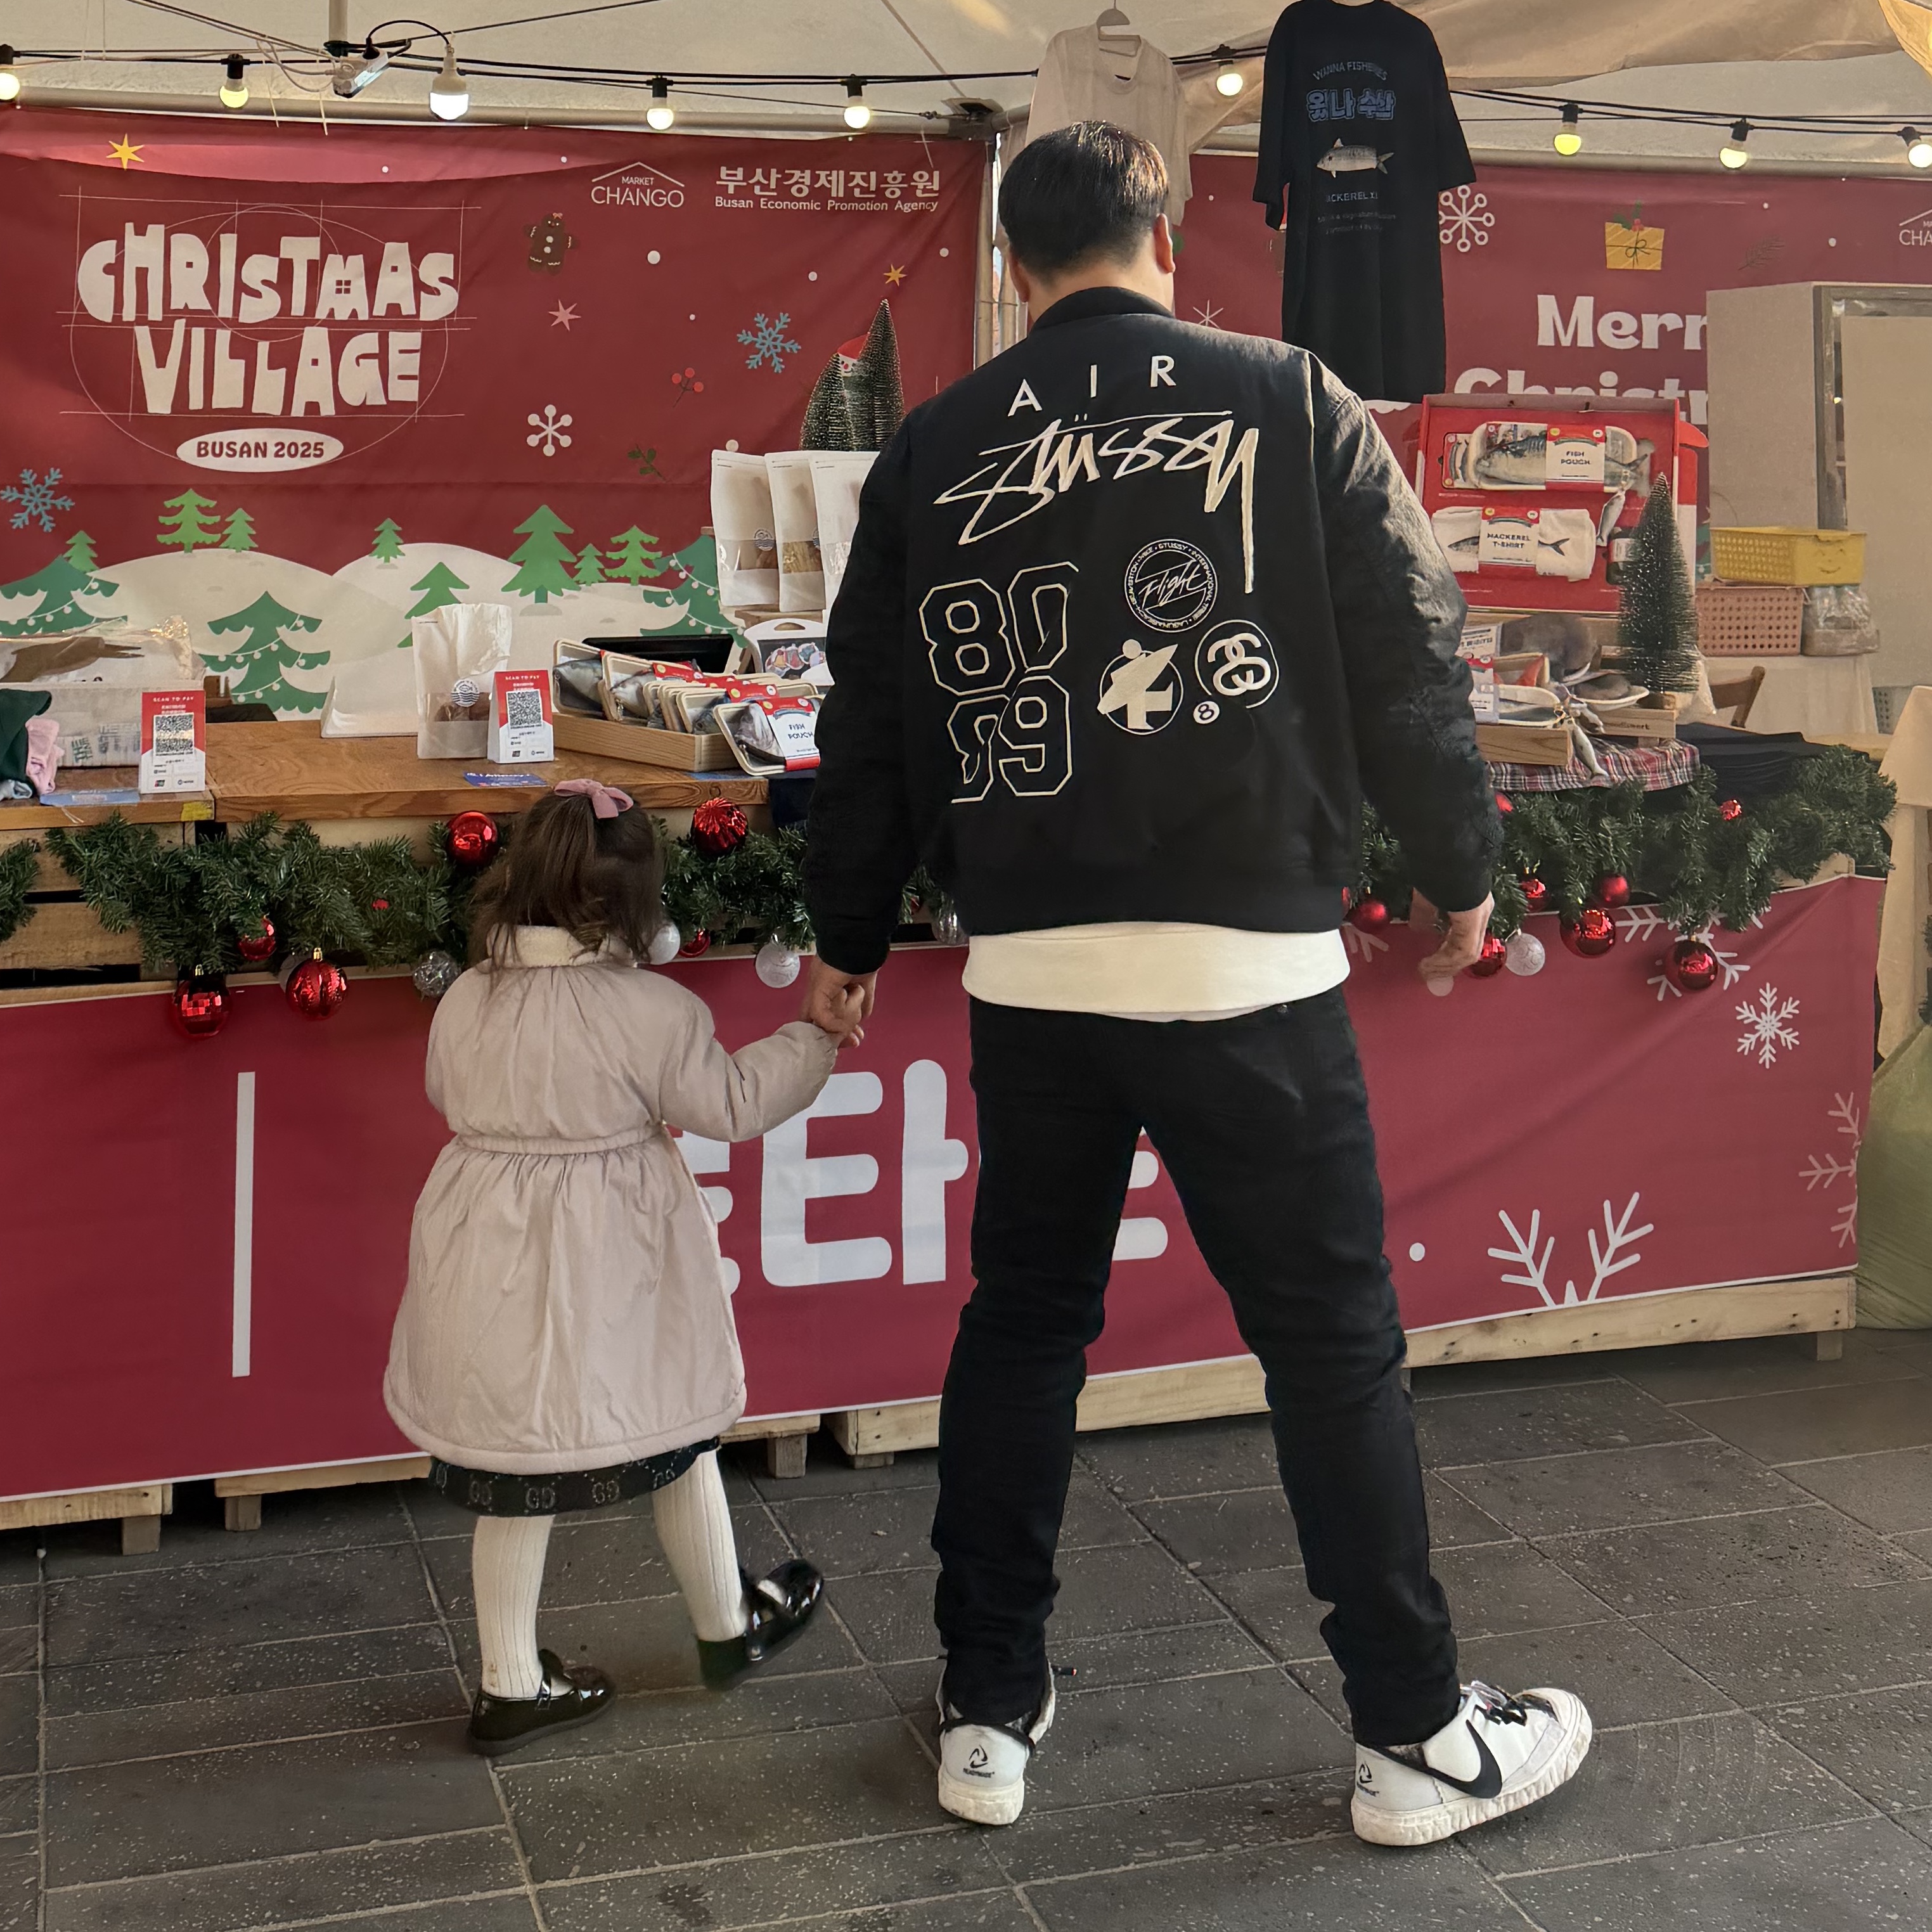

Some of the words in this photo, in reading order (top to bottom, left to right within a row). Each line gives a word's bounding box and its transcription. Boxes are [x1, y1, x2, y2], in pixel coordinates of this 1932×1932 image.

[1357, 88, 1396, 120] 수산
[622, 176, 654, 185] MARKET
[716, 166, 939, 198] 부산경제진흥원
[591, 186, 684, 207] CHANGO
[715, 196, 753, 209] Busan
[761, 198, 821, 210] Economic
[827, 200, 888, 211] Promotion
[894, 200, 938, 213] Agency
[78, 222, 459, 323] CHRISTMAS
[134, 319, 422, 416] VILLAGE
[1008, 355, 1176, 416] AIR
[196, 442, 267, 458] BUSAN
[274, 441, 325, 458] 2025
[1487, 532, 1531, 541] MACKEREL
[1138, 560, 1201, 609] Flight
[1197, 703, 1215, 721] 8
